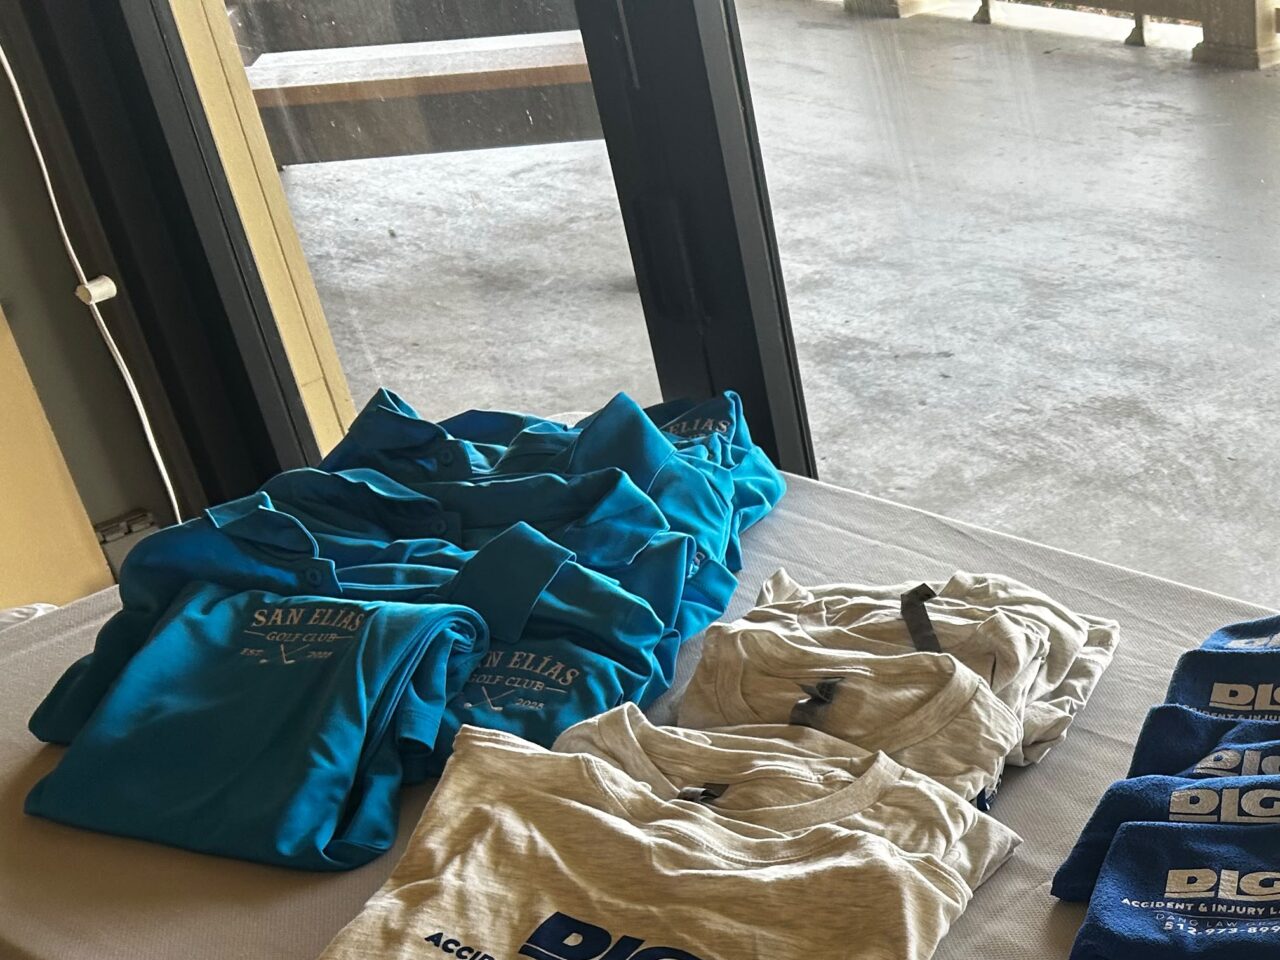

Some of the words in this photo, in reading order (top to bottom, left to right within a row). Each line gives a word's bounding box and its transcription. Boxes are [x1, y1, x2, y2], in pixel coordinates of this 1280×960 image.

[251, 608, 304, 627] SAN
[266, 631, 300, 642] GOLF
[302, 632, 337, 642] CLUB
[505, 676, 545, 691] CLUB
[1121, 897, 1194, 911] ACCIDENT
[1198, 903, 1208, 912] &
[1212, 904, 1266, 915] INJURY
